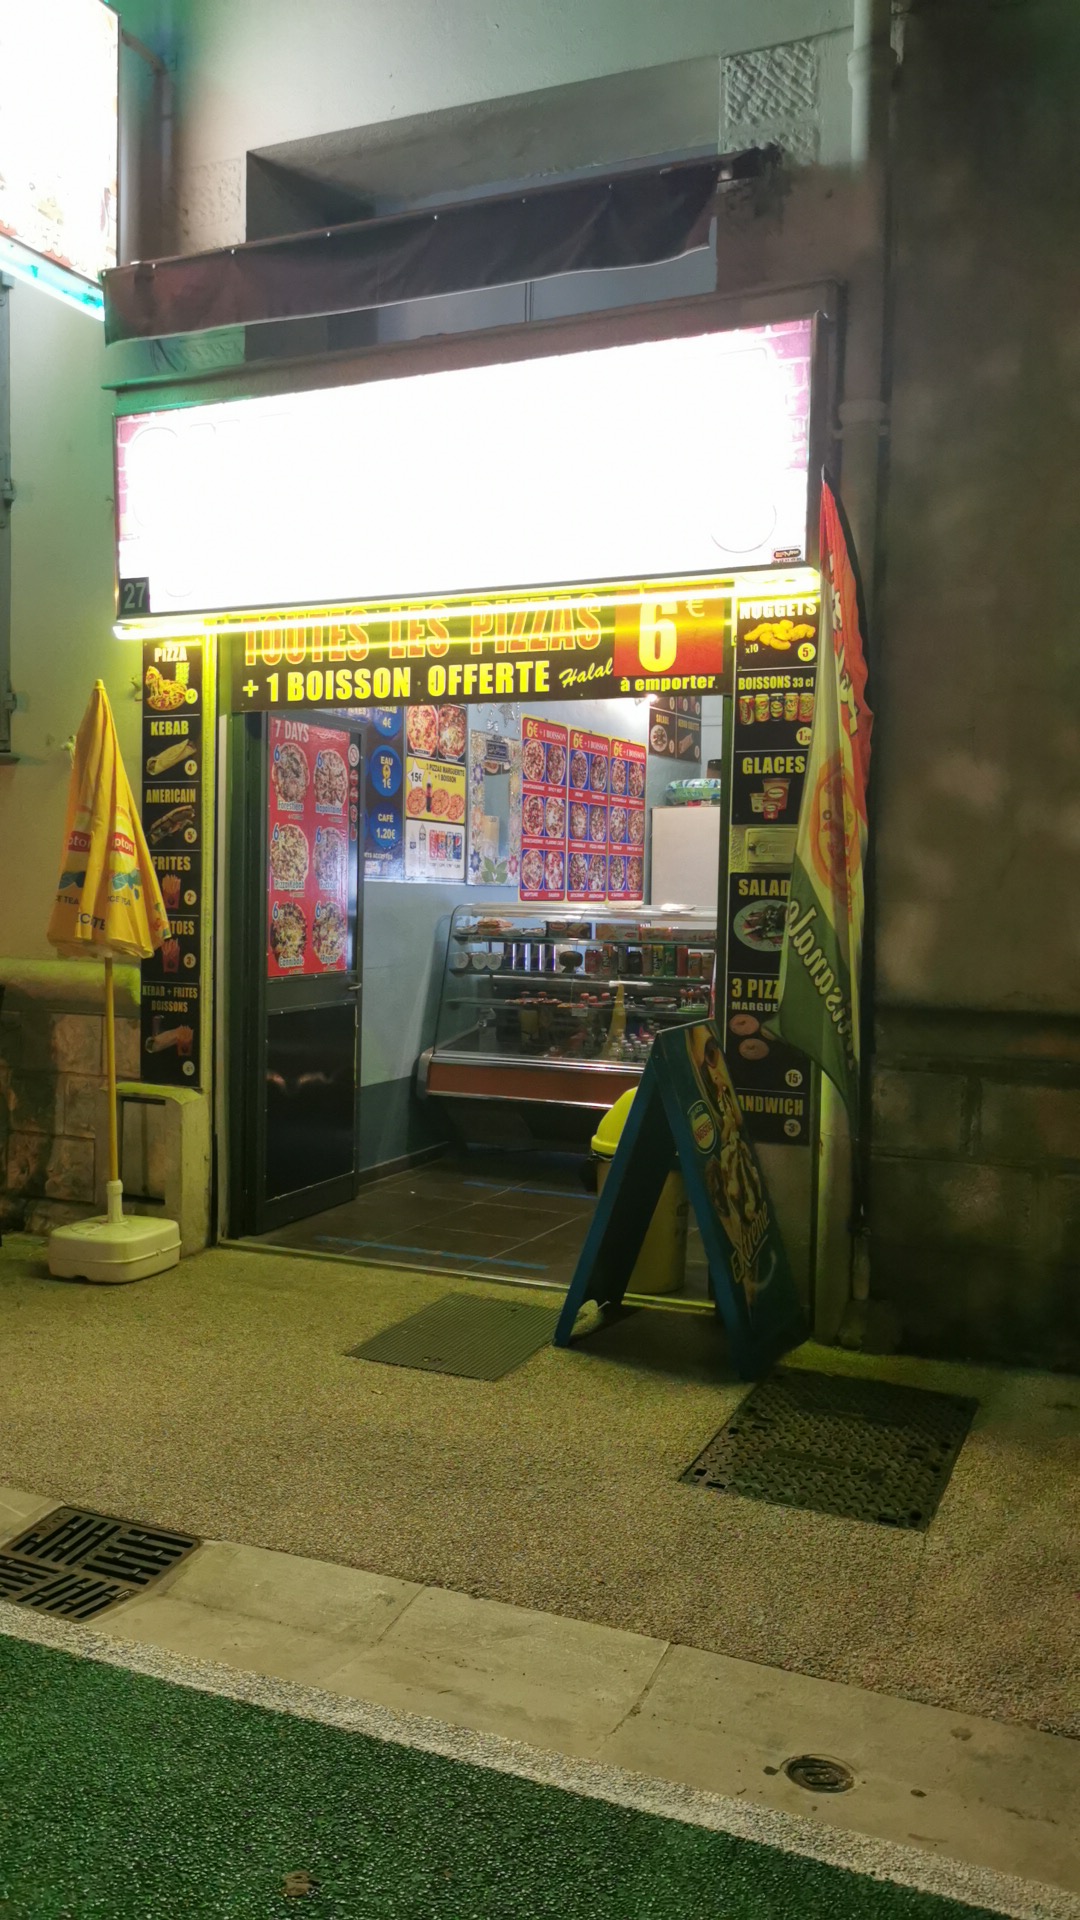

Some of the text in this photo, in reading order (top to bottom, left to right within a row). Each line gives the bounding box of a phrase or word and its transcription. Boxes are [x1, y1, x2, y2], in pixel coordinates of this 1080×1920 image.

[124, 582, 146, 608] 27
[739, 601, 817, 620] NUGGETS
[241, 609, 369, 666] TOUTES
[389, 603, 450, 659] LES
[470, 593, 601, 655] PIZZAS
[154, 646, 187, 662] PIZZA
[243, 680, 259, 697] +
[287, 667, 411, 701] BOISSON
[428, 660, 550, 697] OFFERTE
[559, 657, 613, 688] Halal
[635, 675, 716, 692] emporter
[738, 675, 791, 690] BOISSONS
[792, 678, 804, 688] 33
[151, 721, 189, 736] KEBAB
[275, 720, 309, 742] 7 DAYS
[527, 720, 538, 738] 6€
[573, 732, 583, 748] 6€
[613, 742, 623, 757] 6€
[380, 756, 393, 766] EAU
[742, 756, 806, 775] GLACES
[411, 772, 422, 783] 15€
[146, 788, 197, 804] AMERICAIN
[376, 829, 396, 840] 1.20€
[152, 856, 191, 871] FRITES
[170, 920, 195, 936] TOES
[142, 985, 165, 997] KEBAB
[173, 987, 198, 999] FRITES
[731, 978, 742, 998] 3
[151, 1000, 188, 1013] BOISSONS
